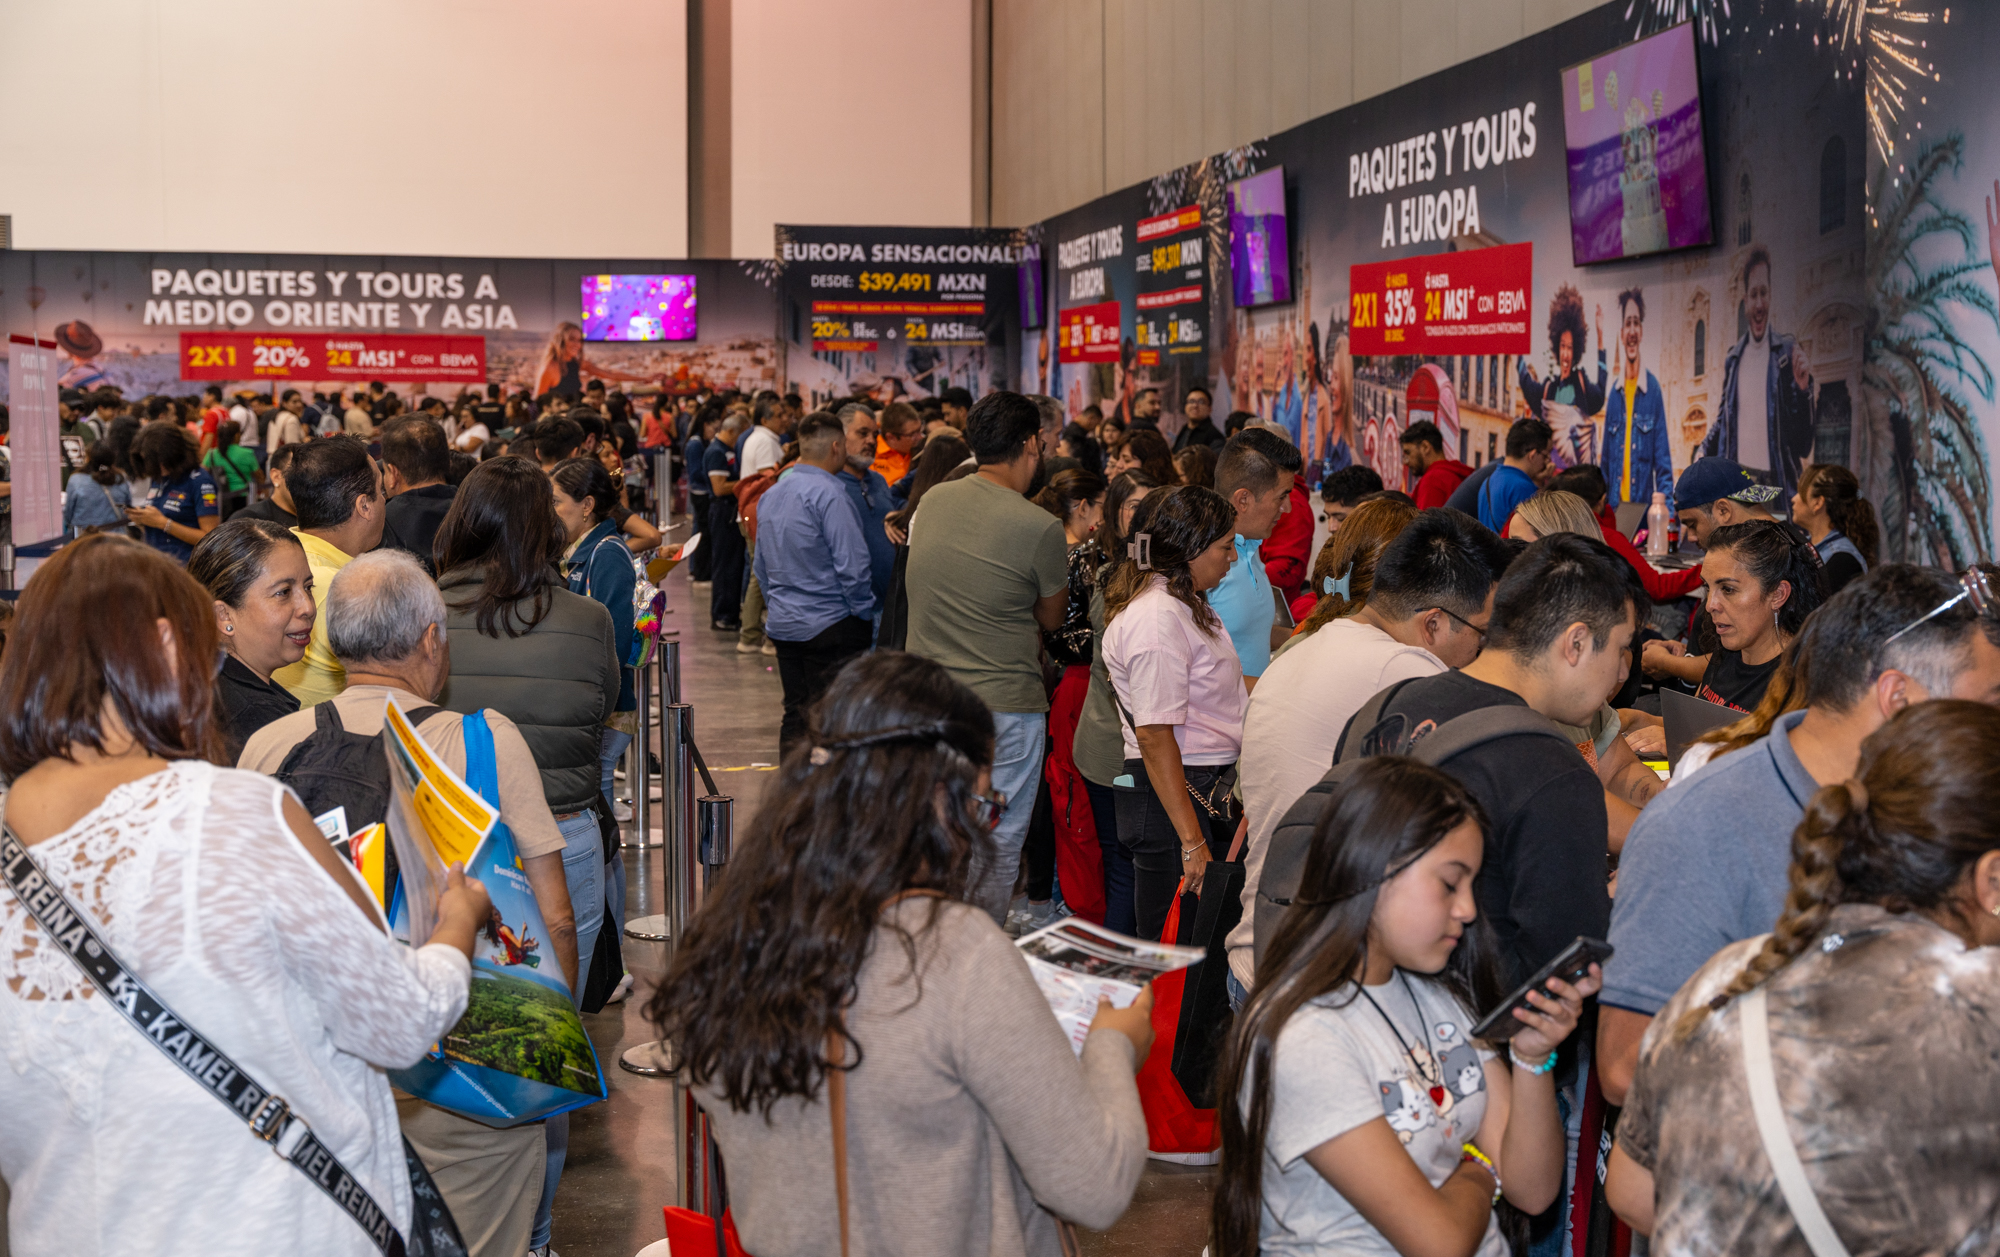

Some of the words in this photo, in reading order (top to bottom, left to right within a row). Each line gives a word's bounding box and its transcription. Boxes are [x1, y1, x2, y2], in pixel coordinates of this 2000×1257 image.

[1349, 131, 1437, 199] PAQUETES
[1441, 125, 1458, 176] Y
[1461, 101, 1537, 172] TOURS
[1381, 202, 1396, 249] A
[1400, 185, 1481, 246] EUROPA
[783, 243, 866, 262] EUROPA
[871, 245, 1014, 264] SENSACIONAL
[1058, 233, 1091, 270] PAQUETES
[1091, 232, 1097, 262] Y
[1096, 224, 1123, 260] TOURS
[151, 268, 317, 297] PAQUETES
[325, 271, 348, 297] Y
[356, 271, 465, 299] TOURS
[474, 274, 499, 300] A
[811, 274, 854, 289] DESDE:
[858, 270, 932, 293] $39,491
[937, 273, 987, 292] MXN
[1069, 273, 1076, 302] A
[1076, 267, 1106, 300] EUROPA
[1431, 273, 1450, 289] HASTA
[143, 299, 254, 326] MEDIO
[264, 301, 400, 328] ORIENTE
[408, 303, 434, 329] Y
[441, 304, 518, 330] ASIA
[1352, 292, 1378, 328] 2X1
[1384, 287, 1417, 328] 35%
[1425, 290, 1441, 322] 24
[1477, 295, 1494, 314] CON
[1498, 287, 1527, 316] BBVA
[811, 321, 850, 339] 20%
[904, 323, 928, 340] 24
[931, 322, 964, 340] MSI
[188, 346, 237, 367] 2X1
[253, 346, 311, 368] 20%
[326, 350, 353, 367] 24
[410, 354, 434, 365] CON
[440, 354, 479, 367] BBVA
[146, 1010, 238, 1098] KAMEL
